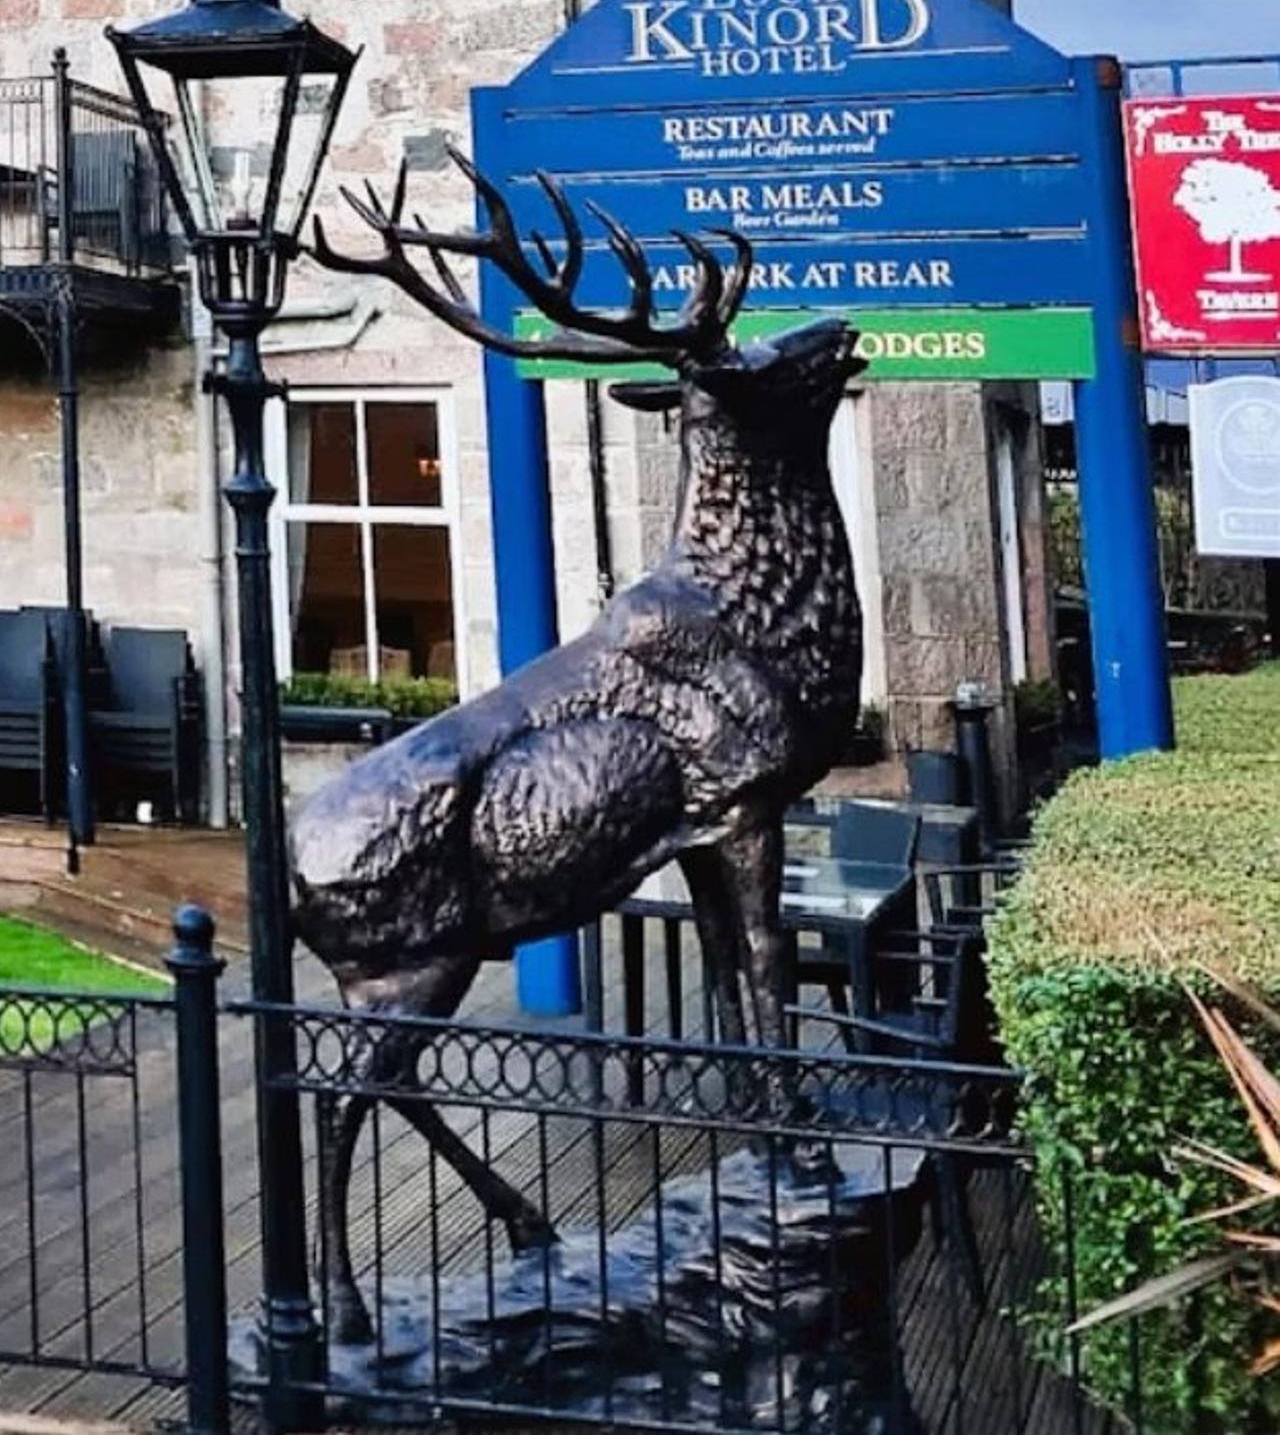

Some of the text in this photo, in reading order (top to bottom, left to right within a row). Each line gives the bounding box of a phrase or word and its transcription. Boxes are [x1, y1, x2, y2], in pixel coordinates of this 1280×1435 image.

[700, 43, 847, 76] HOTEL
[663, 109, 894, 142] RESTAURANT
[717, 143, 752, 158] and
[818, 136, 876, 154] served
[685, 181, 883, 212] BAR MEALS
[628, 265, 698, 291] AR
[801, 263, 846, 287] AT
[853, 260, 954, 287] REAR
